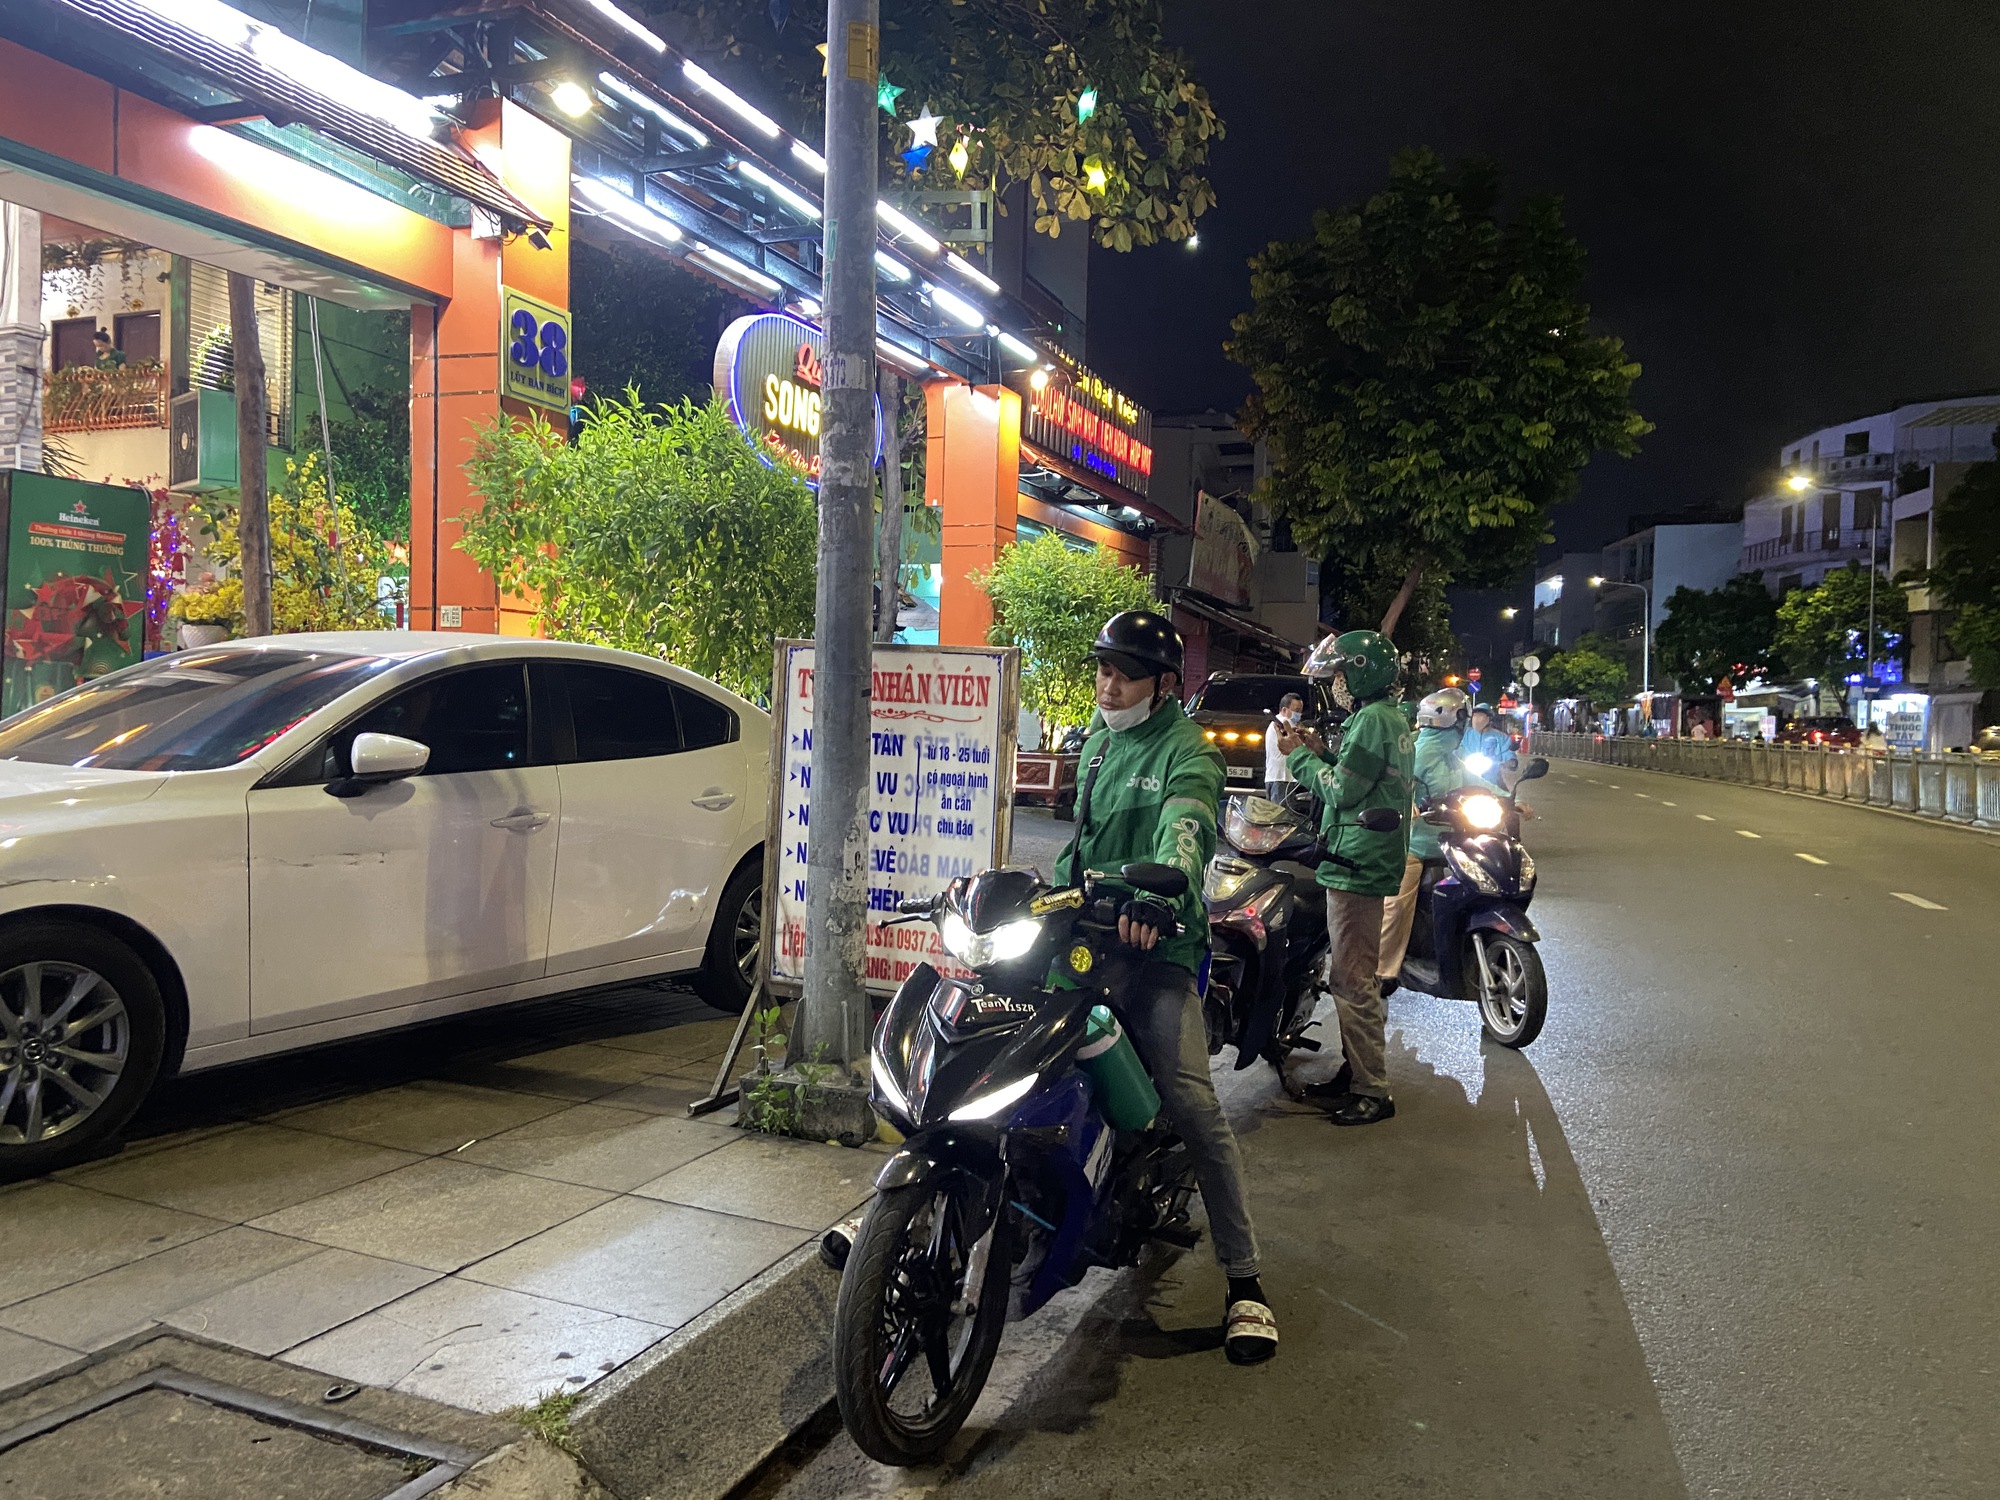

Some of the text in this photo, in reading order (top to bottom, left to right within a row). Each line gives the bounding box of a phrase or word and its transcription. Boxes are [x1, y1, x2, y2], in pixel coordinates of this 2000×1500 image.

[511, 309, 568, 377] 38
[764, 373, 821, 436] SONG
[58, 513, 99, 526] Heineken
[30, 536, 54, 548] 100%
[871, 663, 932, 704] NHÂN
[872, 727, 904, 757] TÂN
[939, 745, 950, 761] 18
[958, 746, 970, 763] 25
[972, 744, 990, 764] tuổi
[877, 771, 898, 801] VỤ
[927, 768, 938, 785] có
[940, 771, 966, 789] ngoại
[941, 792, 972, 812] ân cần
[887, 811, 909, 843] VỤ
[956, 818, 973, 836] đáo
